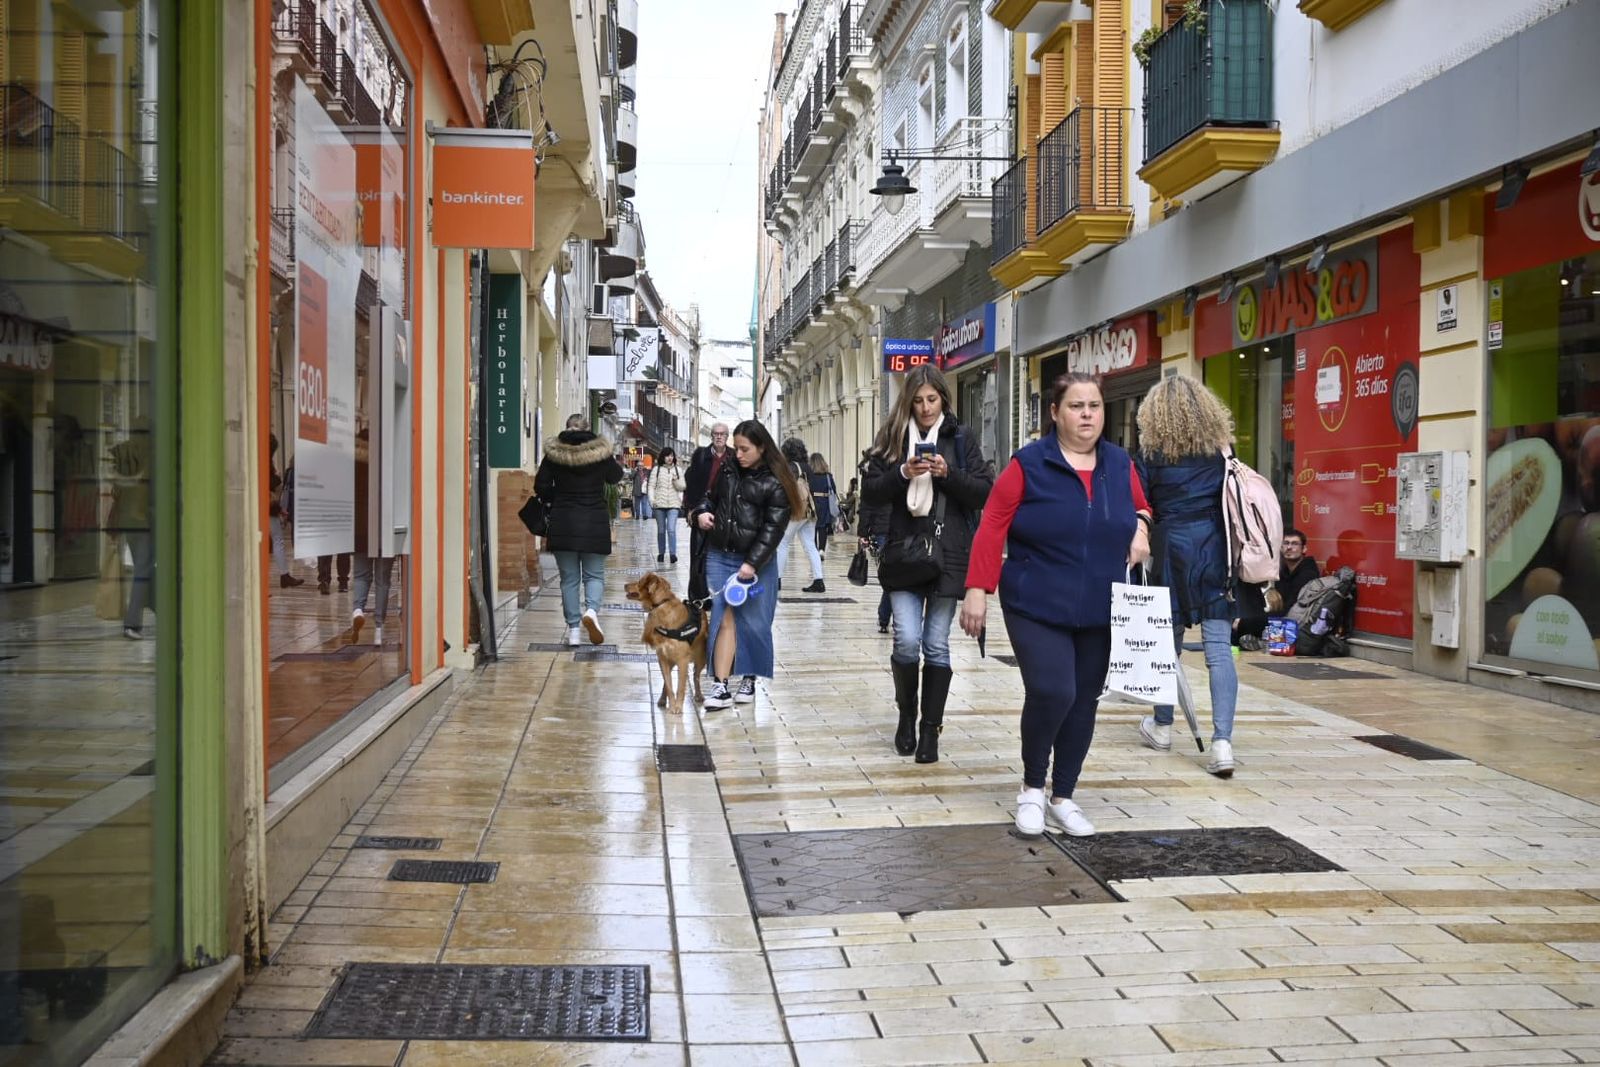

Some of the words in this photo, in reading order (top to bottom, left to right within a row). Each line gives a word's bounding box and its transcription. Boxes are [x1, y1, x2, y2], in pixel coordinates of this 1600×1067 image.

[885, 342, 906, 351] óptica
[891, 355, 904, 371] 16
[1355, 354, 1384, 374] Abierto
[496, 307, 508, 434] Herbolario
[1355, 379, 1369, 398] 365
[1371, 375, 1388, 396] días
[1123, 592, 1138, 602] flying
[1138, 593, 1154, 602] tiger
[1117, 614, 1131, 624] tiger
[1147, 616, 1168, 625] flying
[1124, 638, 1140, 648] flying
[1140, 639, 1157, 649] tiger
[1118, 660, 1134, 670] tiger
[1151, 662, 1171, 671] flying
[1123, 684, 1142, 693] flying
[1143, 684, 1160, 693] tiger
